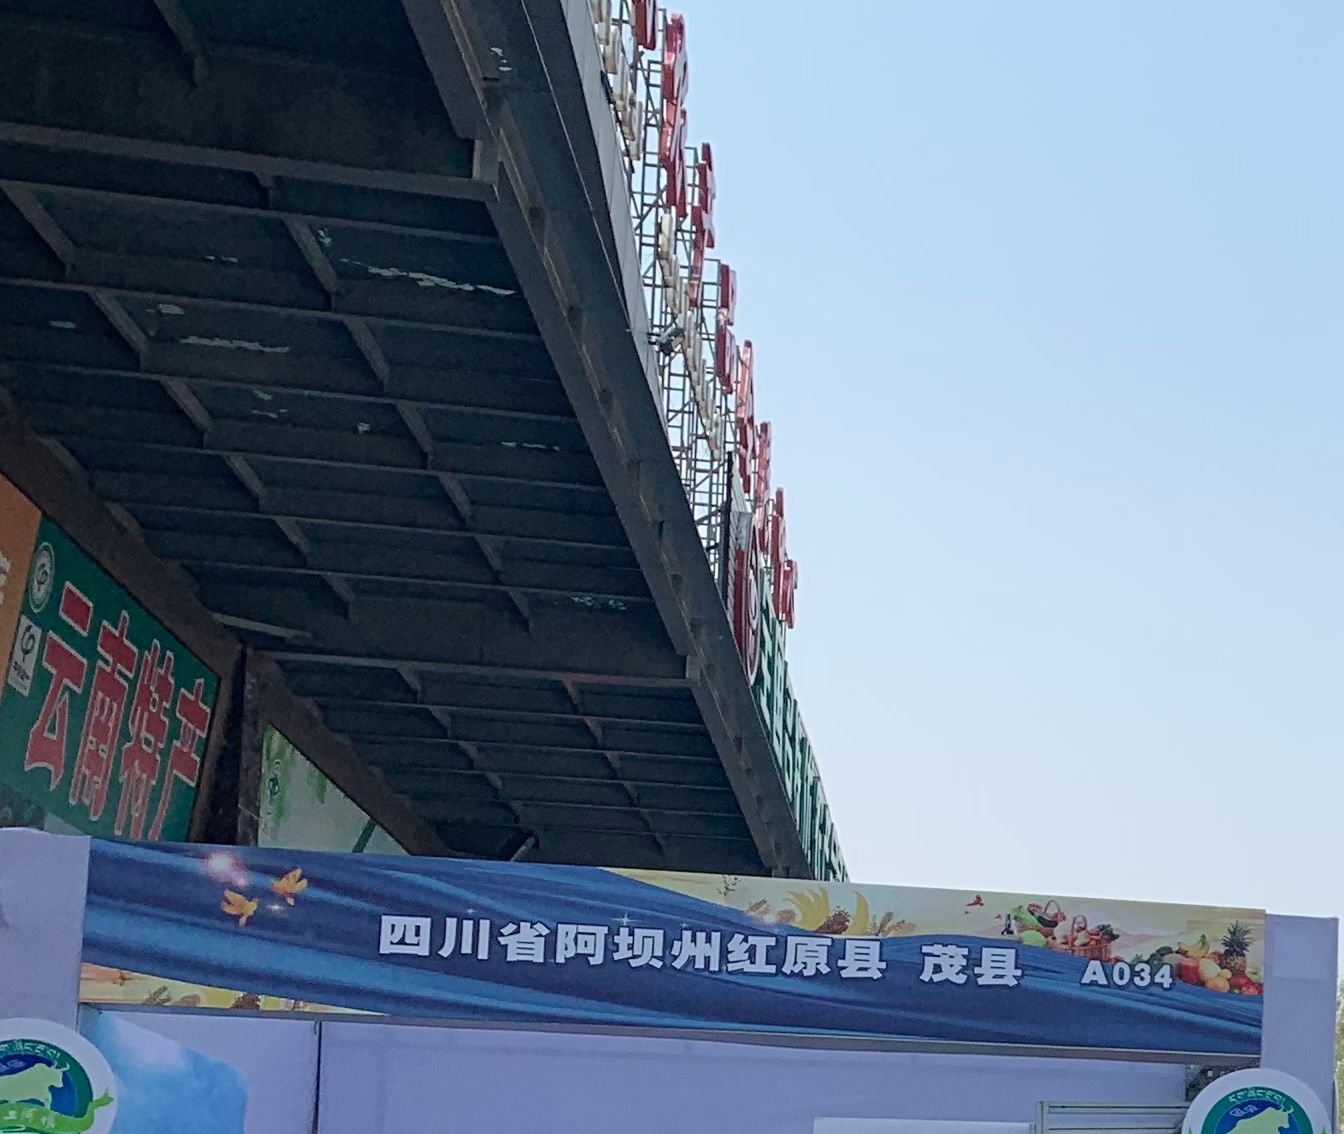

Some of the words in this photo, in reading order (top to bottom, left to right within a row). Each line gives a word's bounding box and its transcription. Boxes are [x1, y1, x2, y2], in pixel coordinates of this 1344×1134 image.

[24, 580, 211, 841] 云南特产
[379, 914, 888, 980] 四川省阿坝州红原县
[919, 942, 1022, 987] 茂县
[1080, 958, 1173, 989] A034
